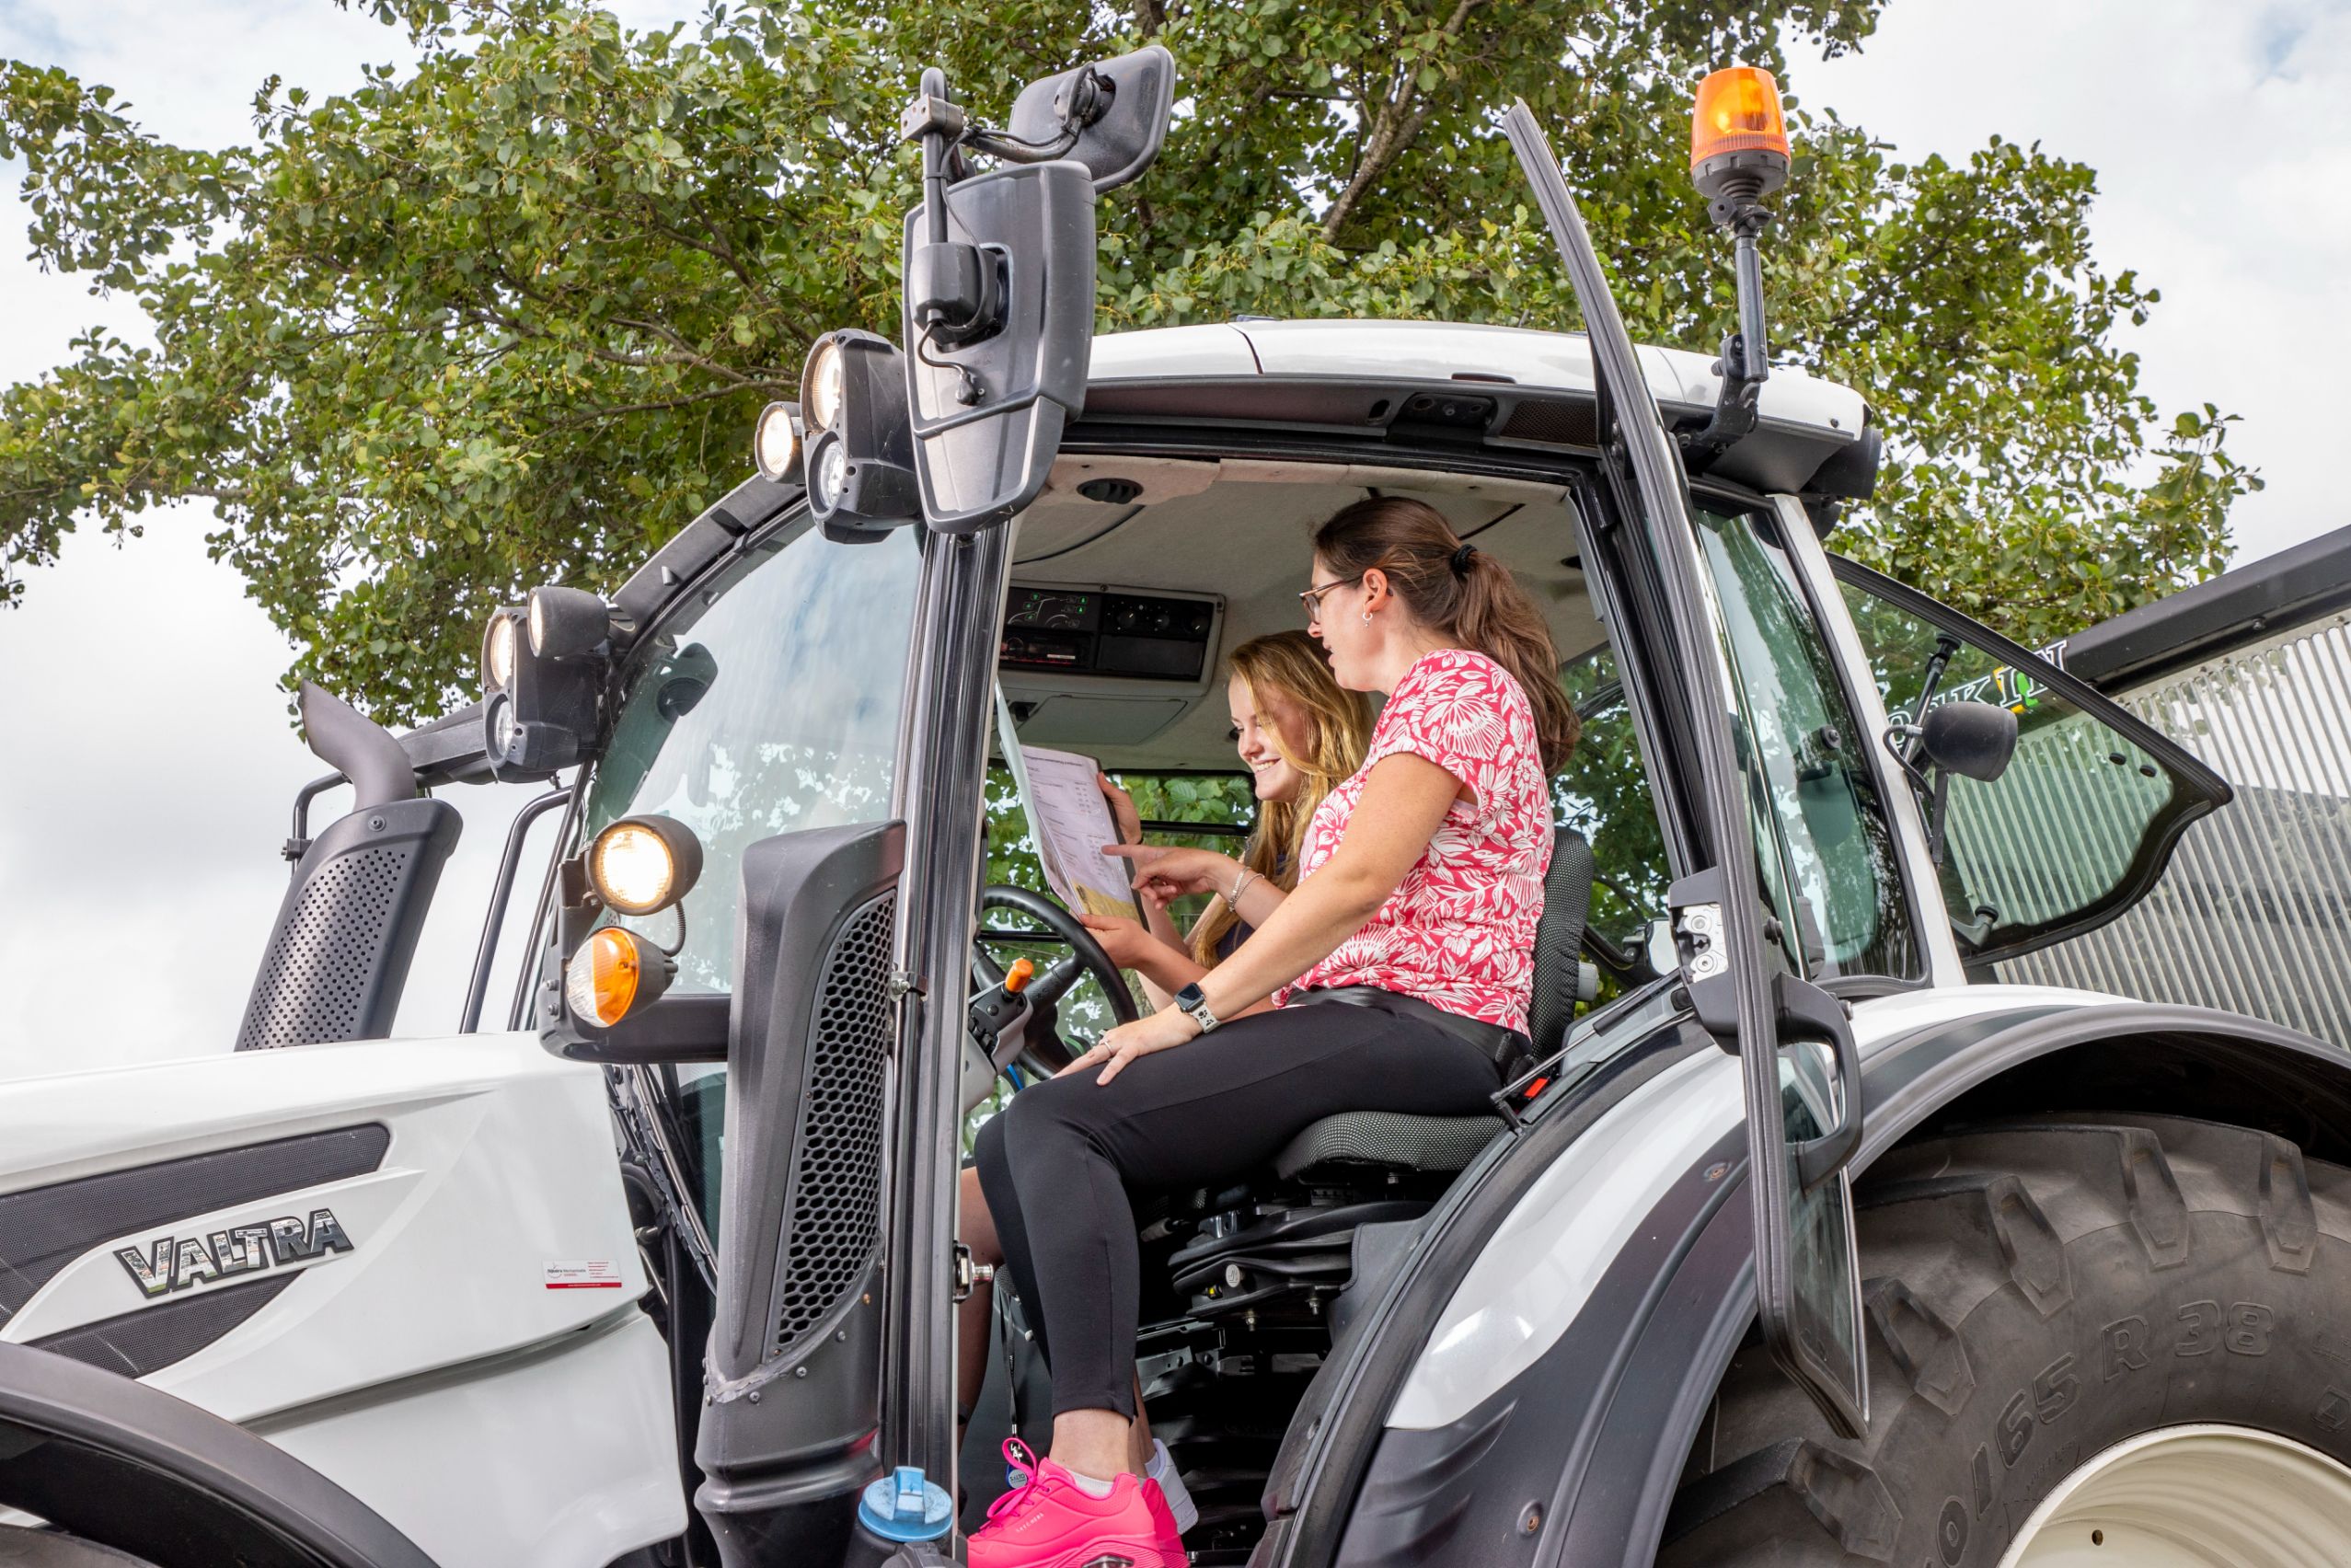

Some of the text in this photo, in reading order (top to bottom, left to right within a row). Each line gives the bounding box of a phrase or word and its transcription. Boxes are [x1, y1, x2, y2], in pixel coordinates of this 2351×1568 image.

[115, 1209, 353, 1297] VALTRA
[1923, 1352, 2082, 1568] 0/65
[2100, 1314, 2150, 1383] R
[2174, 1299, 2276, 1357] 38
